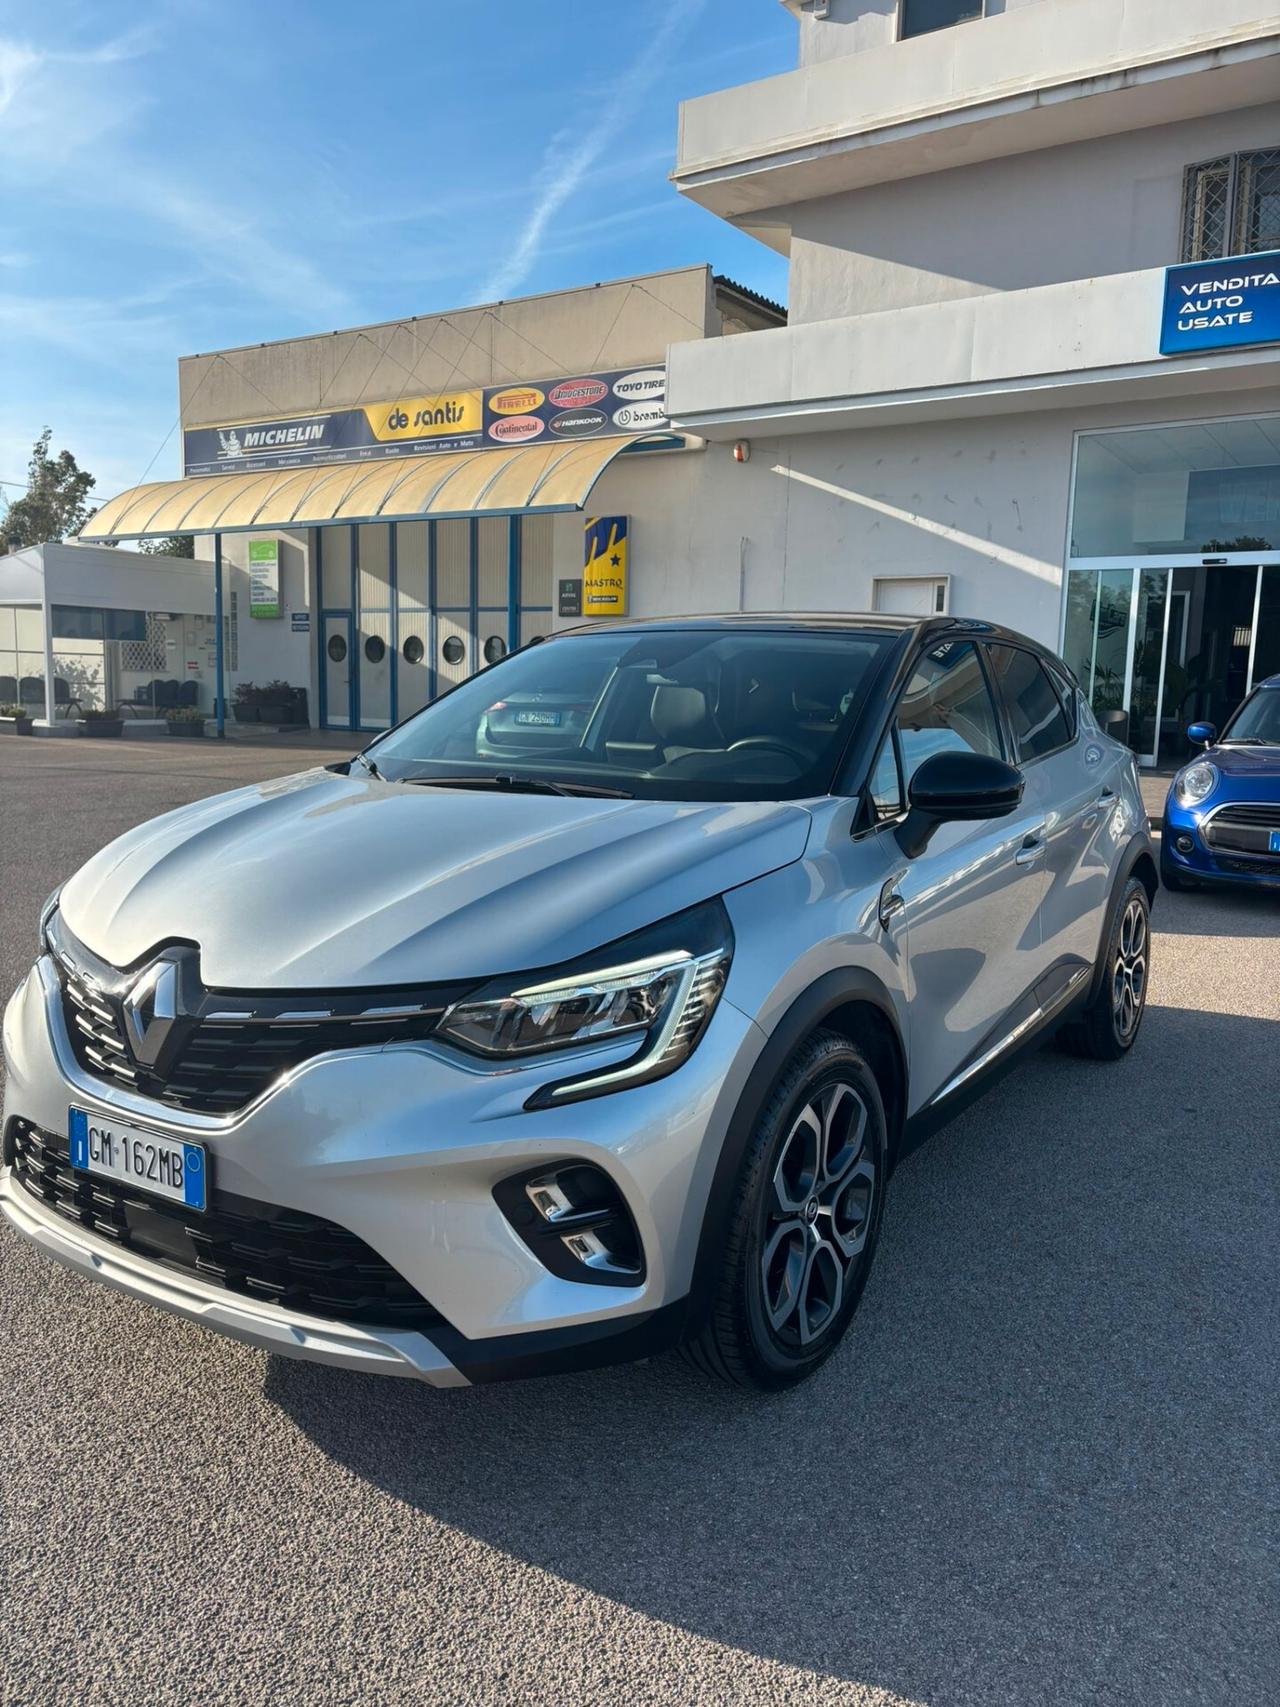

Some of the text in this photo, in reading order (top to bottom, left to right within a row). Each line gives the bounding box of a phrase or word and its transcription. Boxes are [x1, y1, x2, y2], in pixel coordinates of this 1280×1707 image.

[1181, 273, 1280, 295] VENDITA
[1179, 295, 1244, 314] AUTO
[1177, 311, 1253, 331] USATE
[616, 380, 665, 392] TOYO TIRE
[496, 393, 537, 409] PIRELLI
[388, 401, 465, 430] de santis
[633, 408, 665, 421] bremb
[244, 424, 325, 447] MICHELIN
[495, 421, 538, 437] Continental
[88, 1127, 112, 1166] GM
[122, 1137, 183, 1188] 162MB
